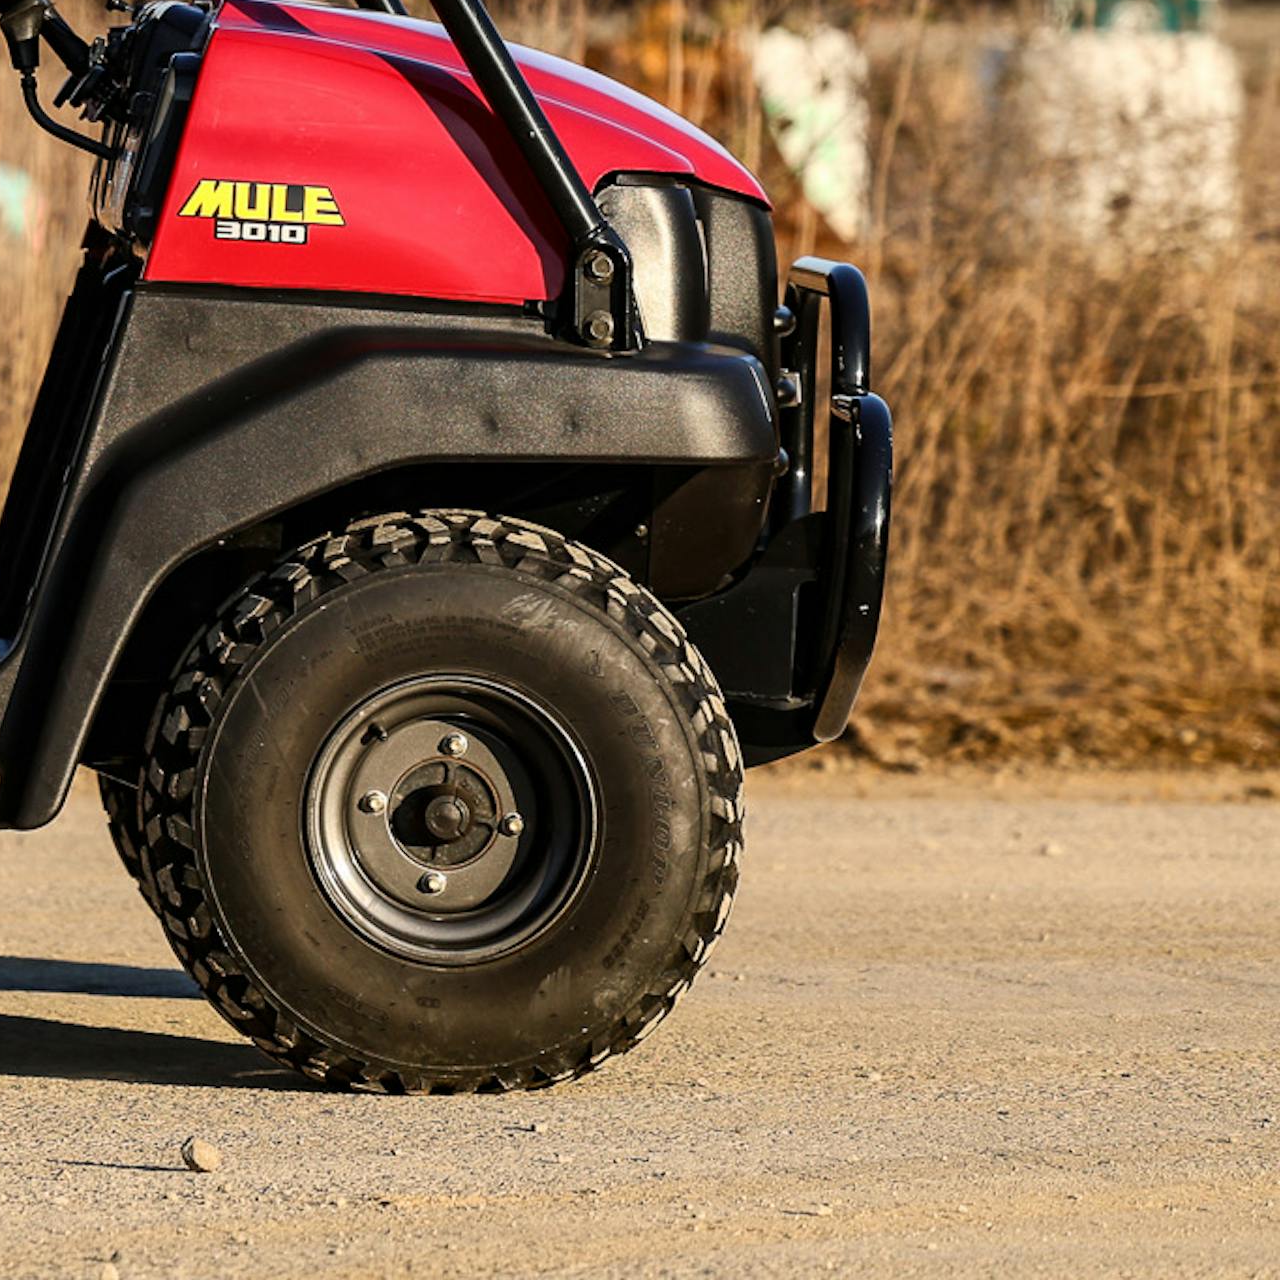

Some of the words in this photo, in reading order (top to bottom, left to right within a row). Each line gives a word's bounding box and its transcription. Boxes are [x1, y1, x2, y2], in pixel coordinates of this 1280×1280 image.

[178, 179, 346, 225] MULE
[215, 220, 307, 244] 3010
[608, 689, 673, 888] DUNLOP
